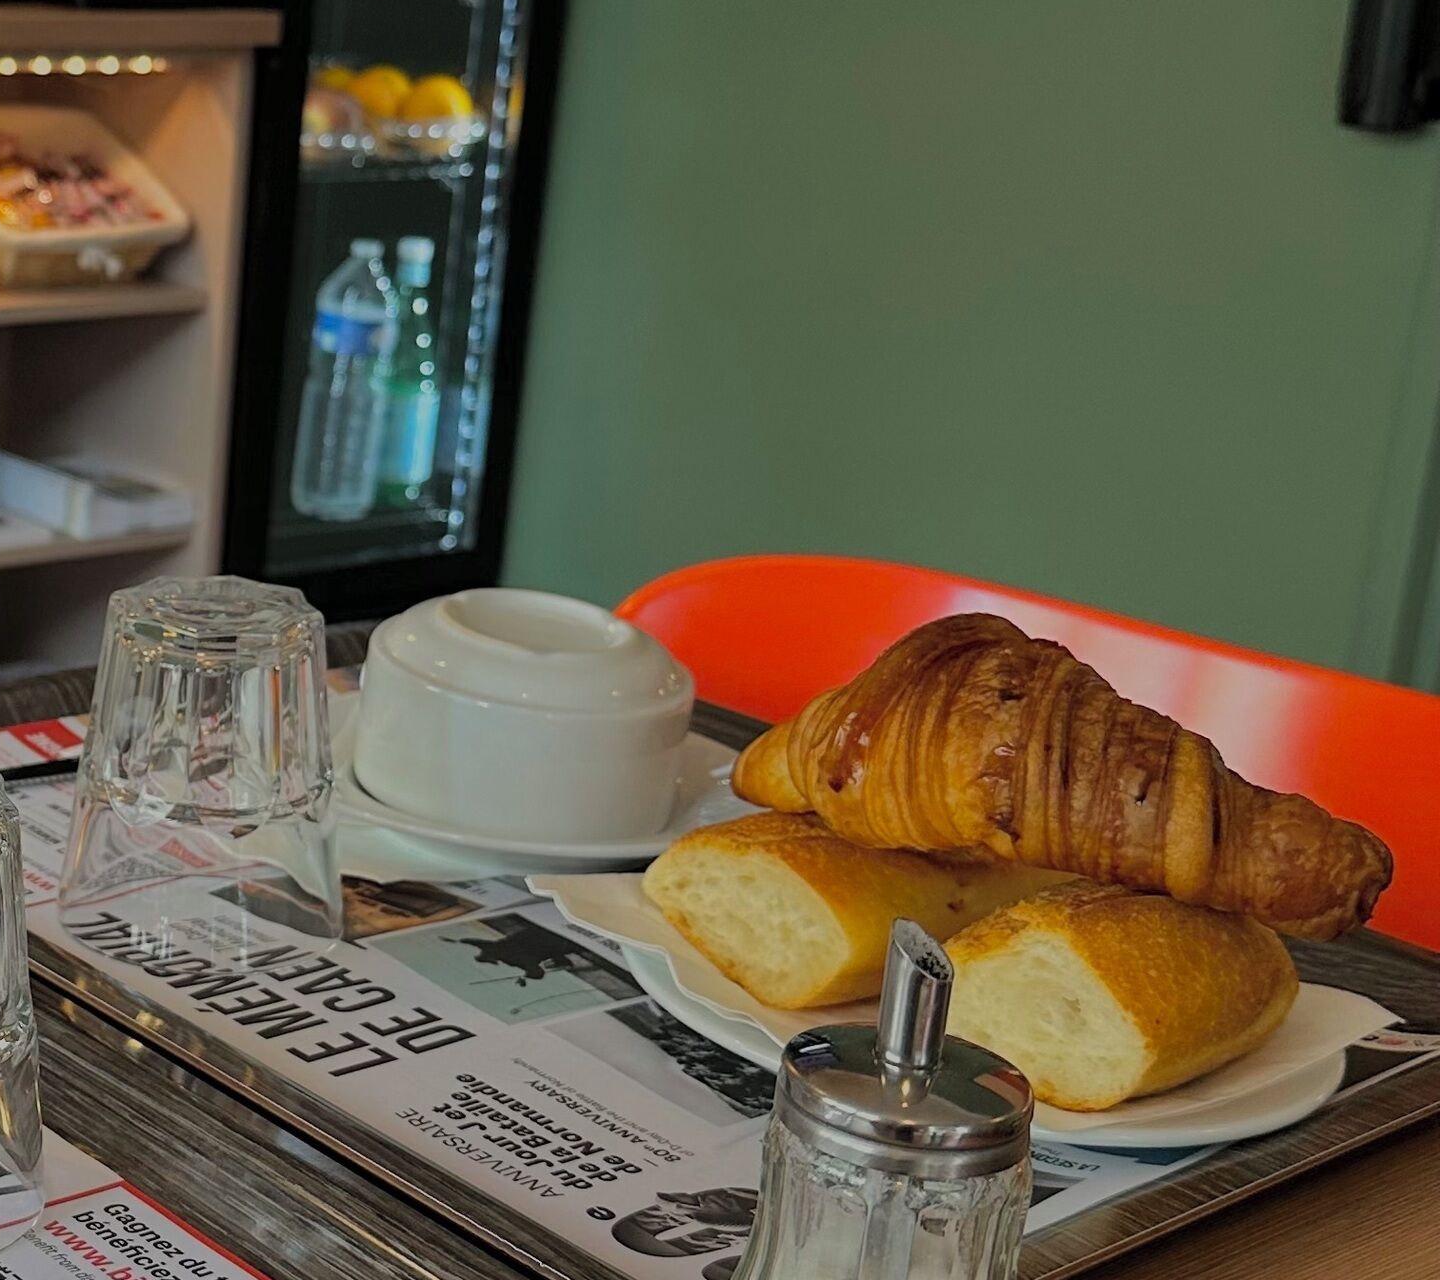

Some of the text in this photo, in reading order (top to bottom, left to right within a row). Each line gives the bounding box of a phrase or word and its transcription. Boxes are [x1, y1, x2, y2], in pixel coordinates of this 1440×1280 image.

[62, 911, 329, 1041] MÉMORIAL
[231, 944, 477, 1055] DE CAEN
[285, 1031, 399, 1077] LE
[395, 1107, 564, 1200] ANNIVERSAIRE
[432, 1101, 593, 1191] du Jour J et
[450, 1091, 618, 1184] de la Bataille
[456, 1072, 643, 1176] de Normandie
[525, 1079, 646, 1144] ANNIVERSARY
[103, 1203, 184, 1258] Gagnez
[178, 1256, 213, 1278] du
